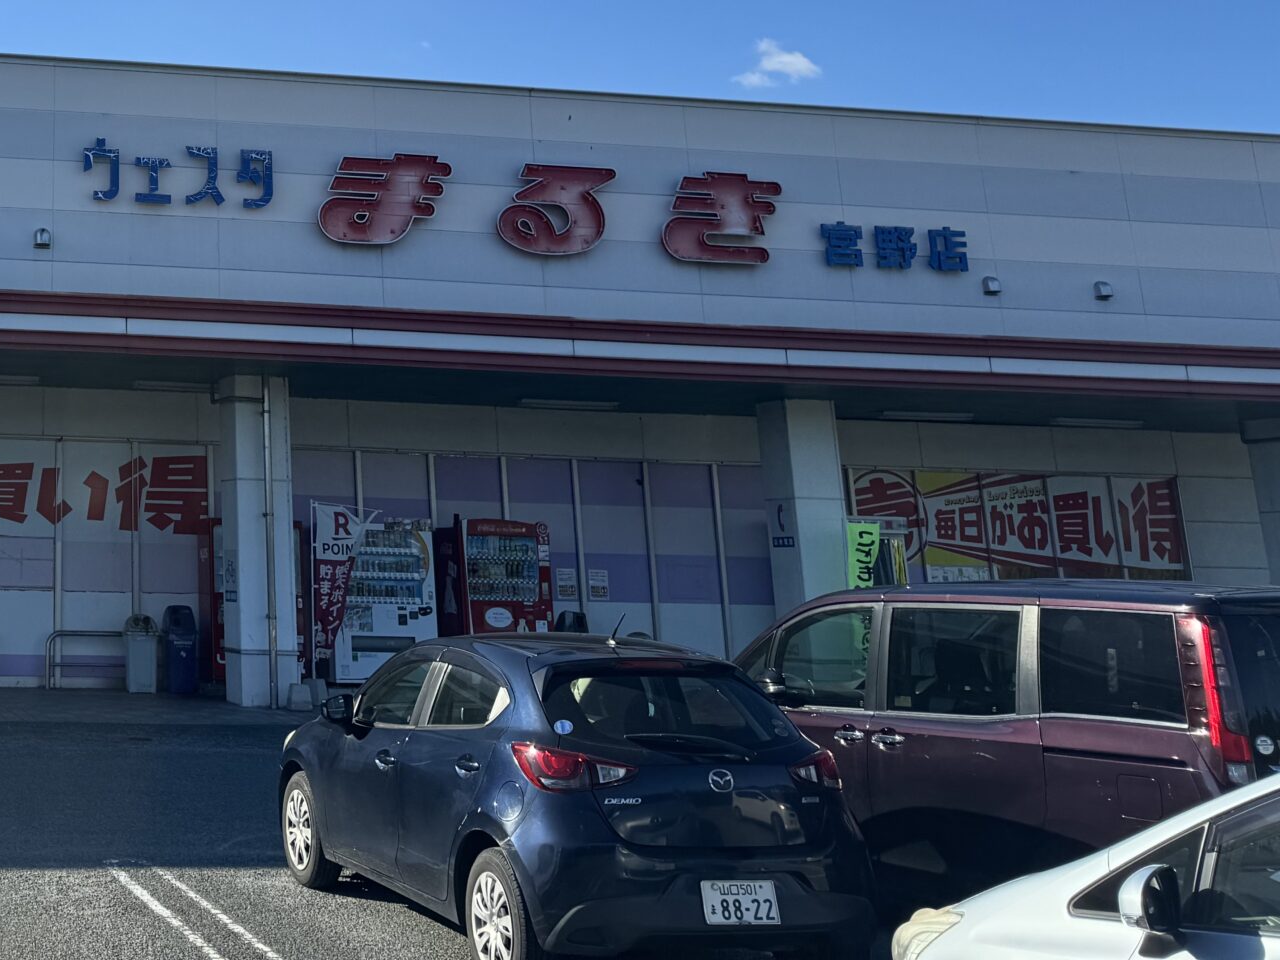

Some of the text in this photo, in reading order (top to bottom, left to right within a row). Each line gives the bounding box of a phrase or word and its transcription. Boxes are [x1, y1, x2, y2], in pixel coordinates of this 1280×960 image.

[83, 137, 969, 272] ウェスタ まるき 宮野店
[987, 489, 1007, 501] Low
[333, 512, 352, 536] R
[935, 481, 1181, 564] 毎日がお買い得
[604, 797, 642, 805] DEMIO
[720, 898, 775, 921] 88-22
